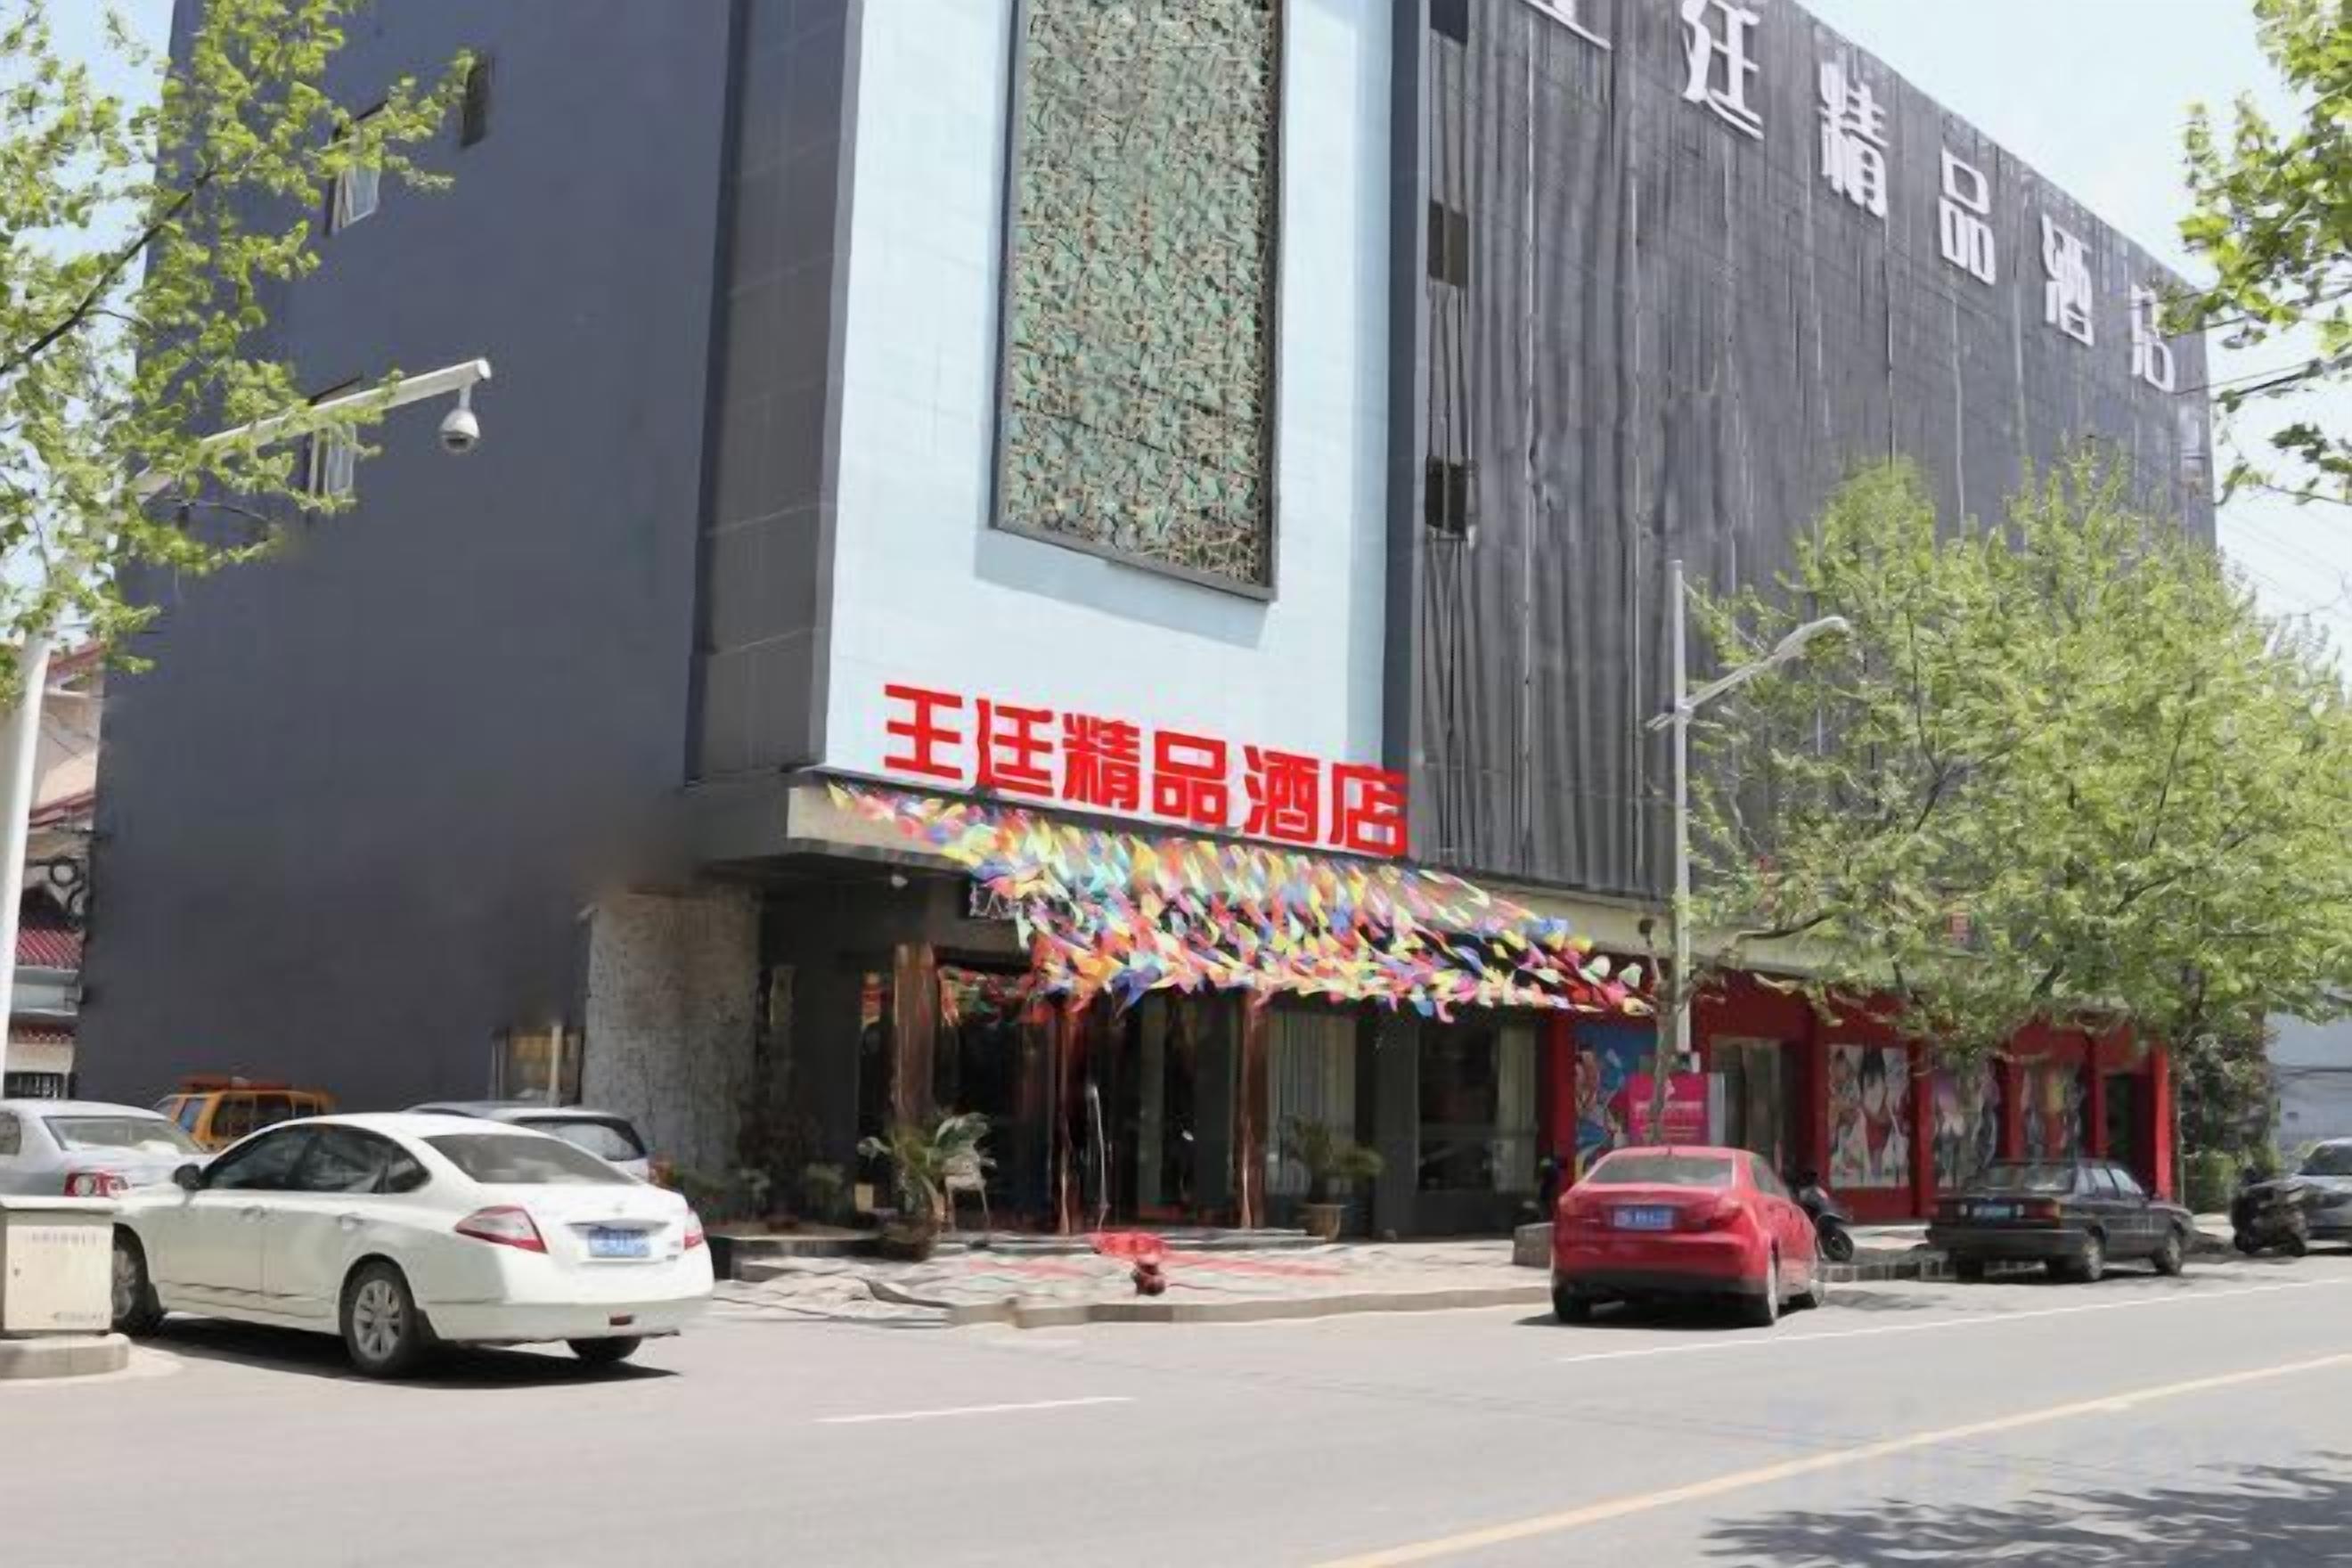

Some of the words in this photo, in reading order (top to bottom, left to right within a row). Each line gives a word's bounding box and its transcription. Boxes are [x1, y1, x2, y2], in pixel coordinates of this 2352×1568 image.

[1523, 0, 2176, 393] 廷精品酒店
[885, 683, 1407, 858] 王廷精品酒店
